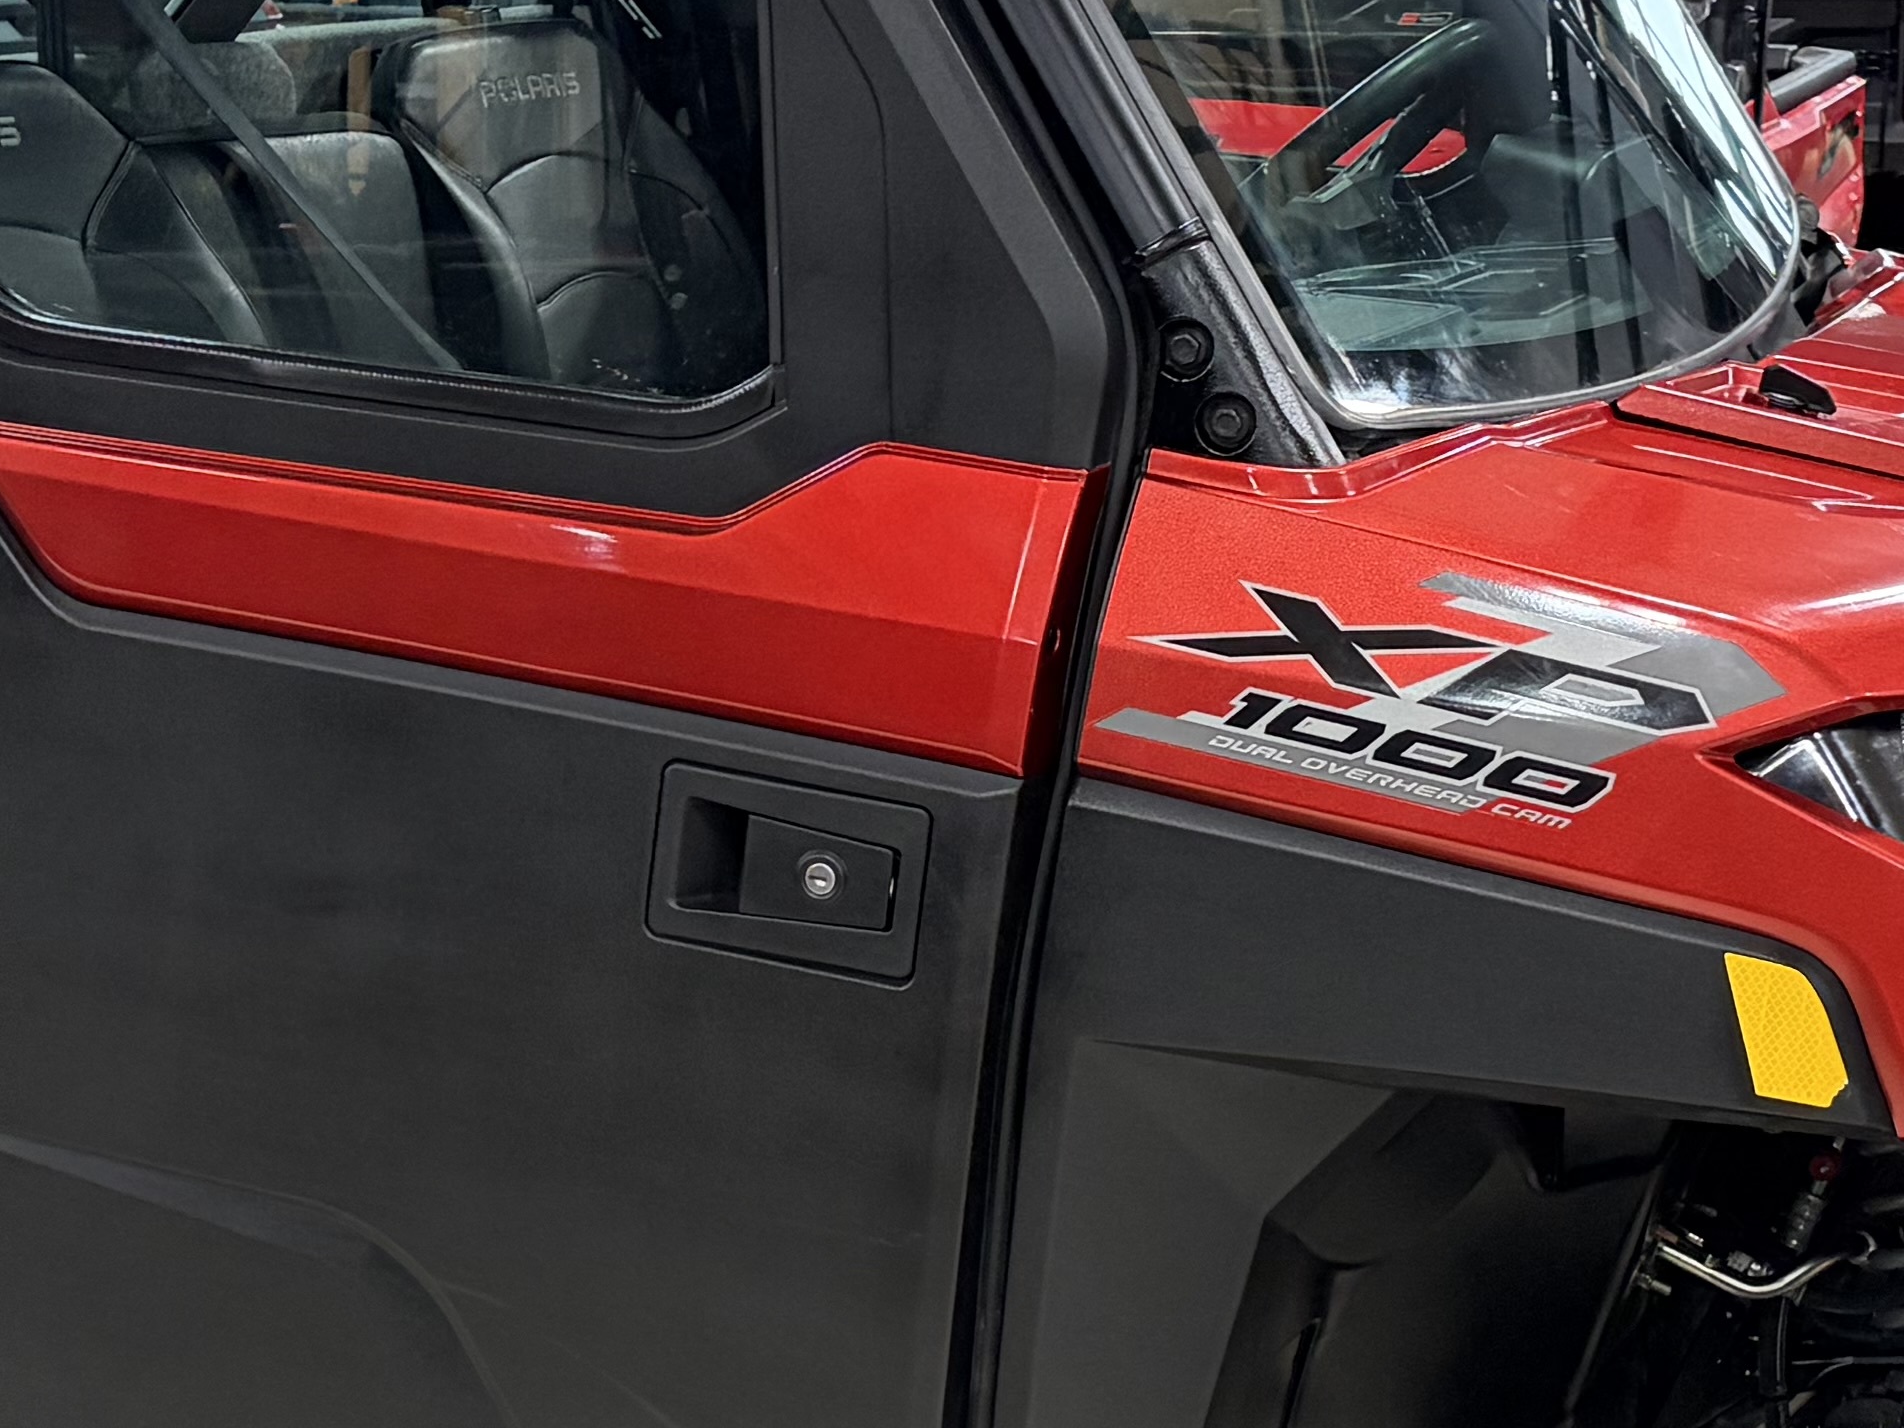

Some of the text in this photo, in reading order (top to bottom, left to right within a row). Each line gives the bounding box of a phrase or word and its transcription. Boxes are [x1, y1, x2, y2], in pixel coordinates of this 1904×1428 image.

[479, 71, 582, 109] POLARIS
[1127, 580, 1718, 735] XP
[1208, 733, 1573, 830] DUAL OVERHEAD CAM
[1215, 686, 1615, 813] 1000
